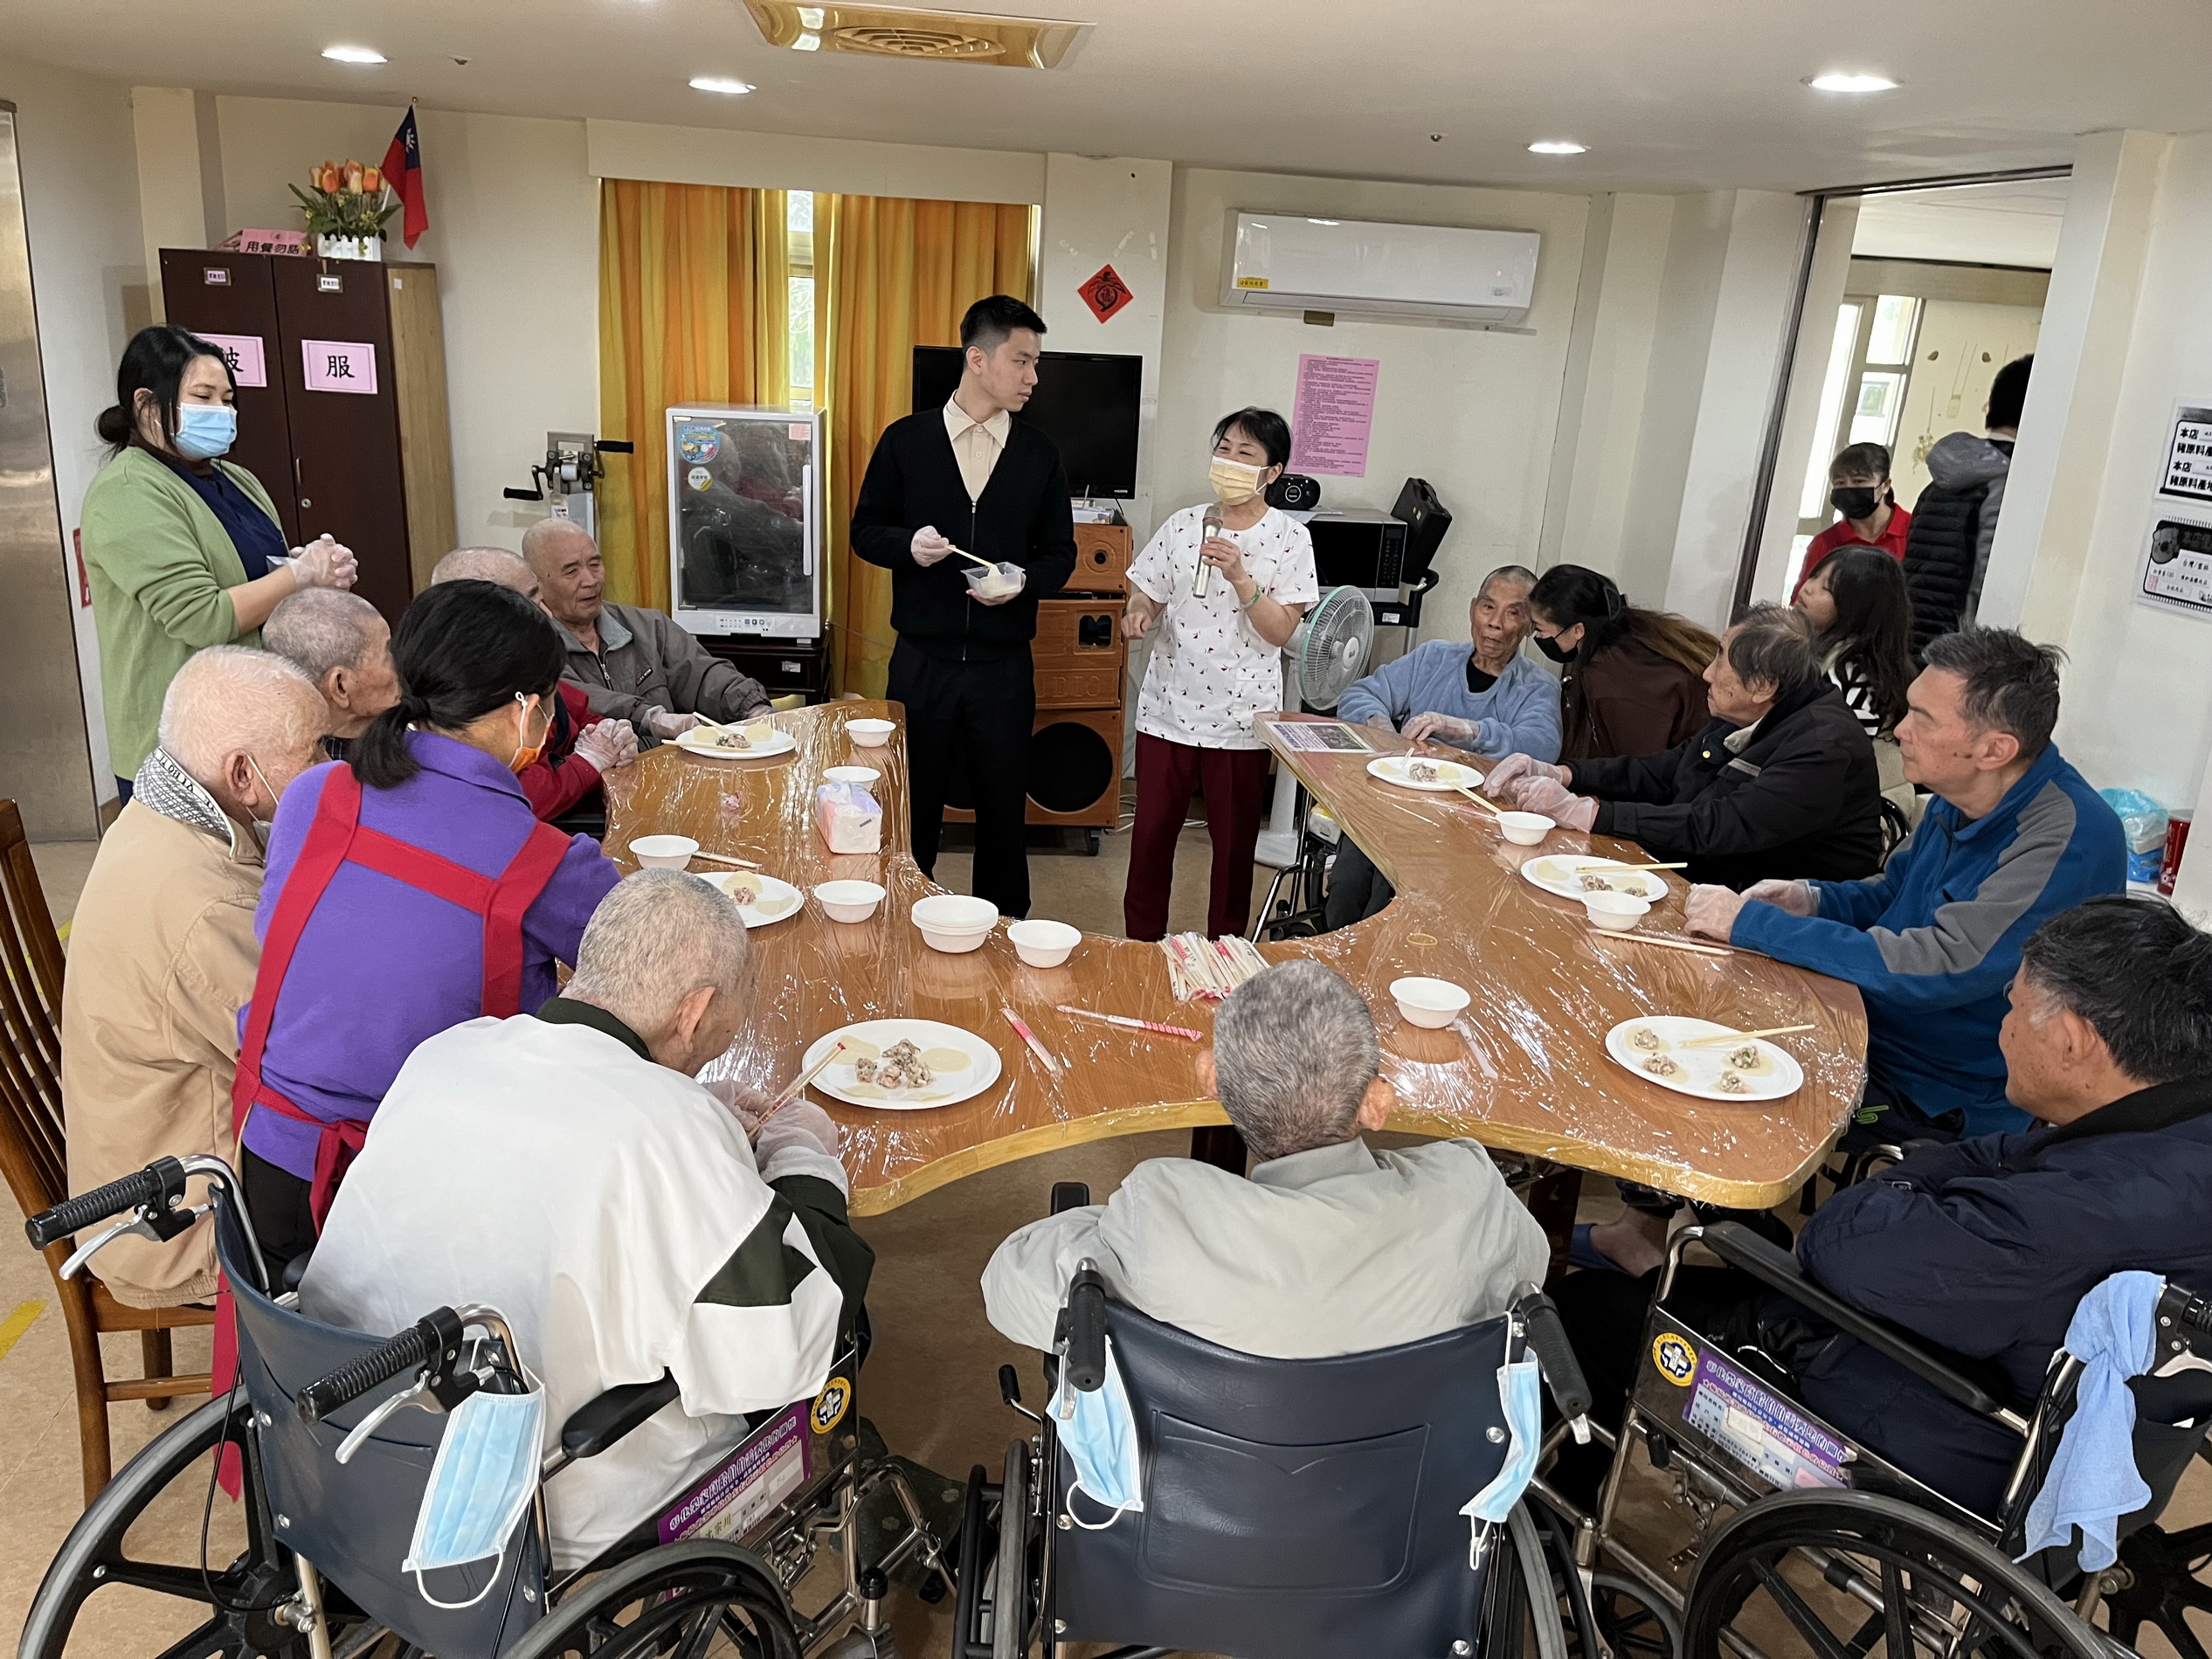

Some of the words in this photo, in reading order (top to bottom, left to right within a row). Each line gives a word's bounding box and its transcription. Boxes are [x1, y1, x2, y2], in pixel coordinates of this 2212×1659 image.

[326, 355, 356, 378] 服
[2180, 427, 2200, 439] 本店
[2173, 460, 2193, 473] 本店
